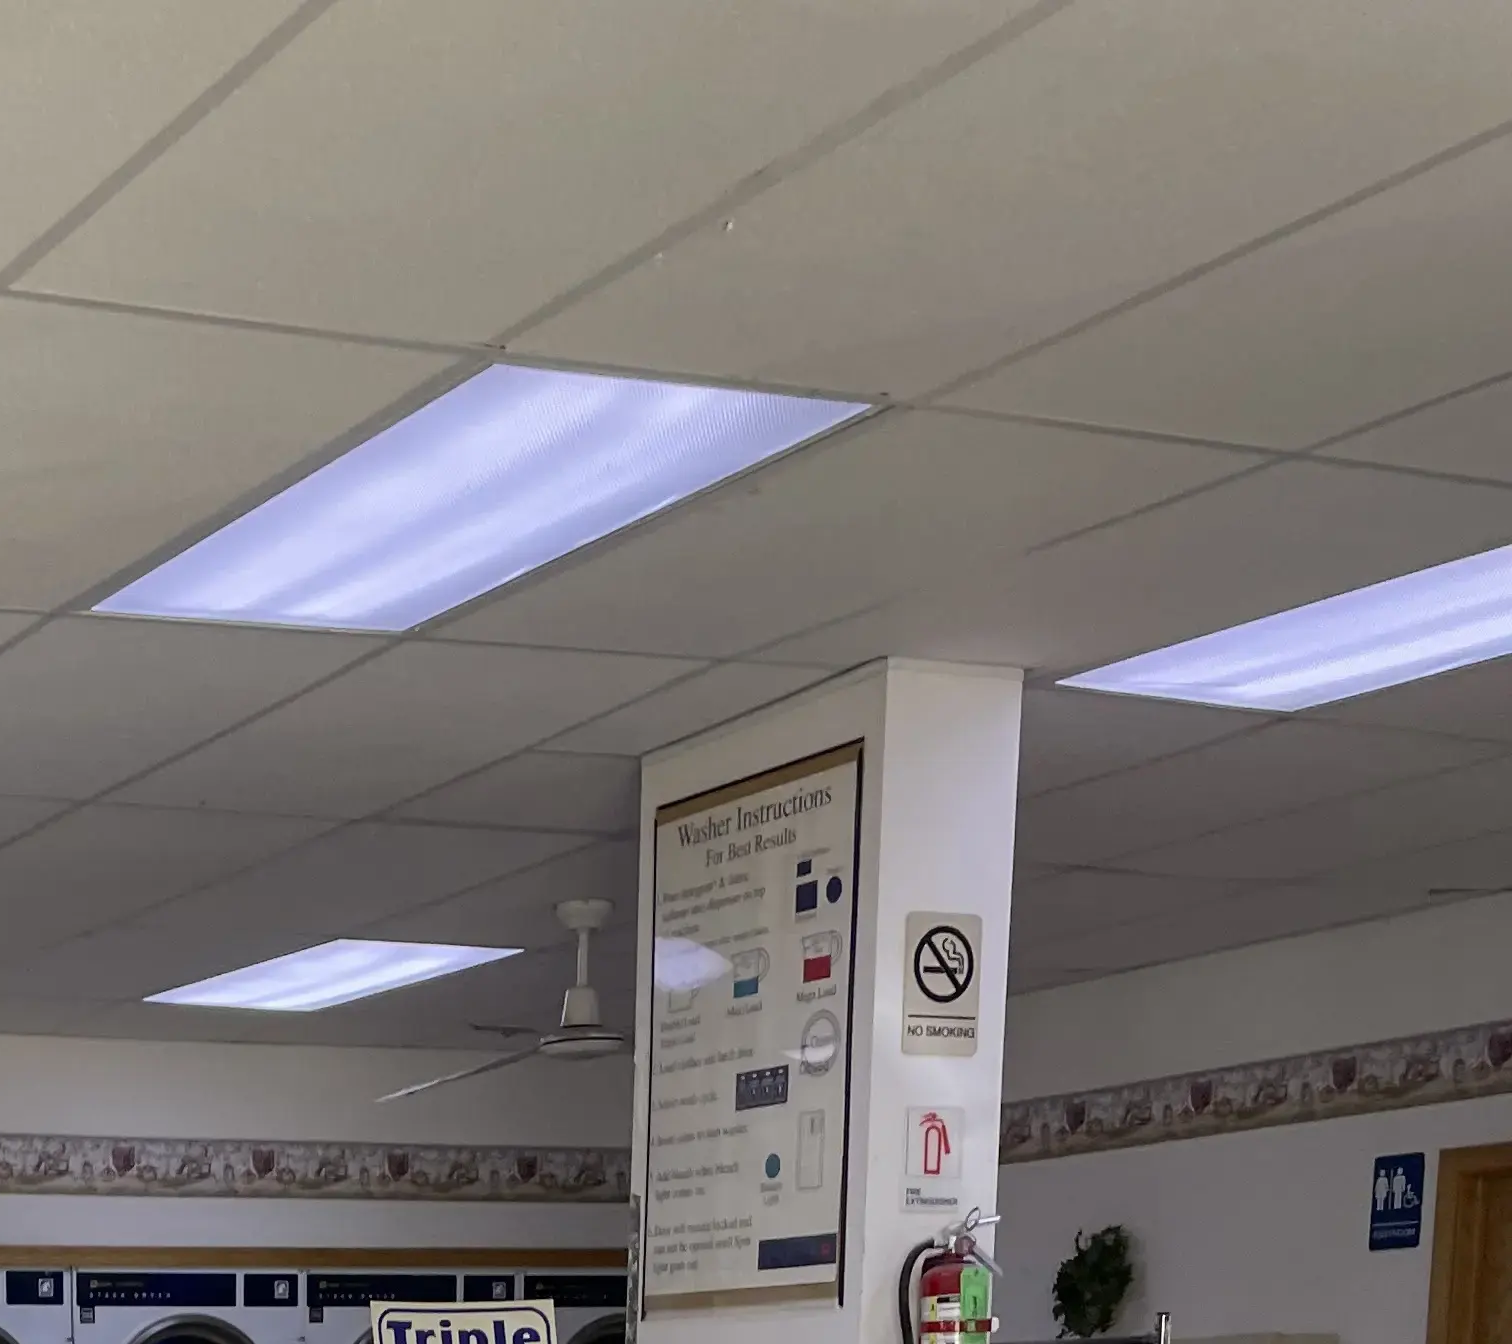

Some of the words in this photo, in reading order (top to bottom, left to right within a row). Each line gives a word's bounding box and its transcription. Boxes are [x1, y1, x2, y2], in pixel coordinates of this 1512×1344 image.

[678, 814, 732, 848] Washer
[737, 785, 833, 832] Instructions
[705, 848, 724, 868] For
[727, 840, 752, 862] Best
[754, 827, 797, 853] Results
[907, 1025, 923, 1037] NO
[925, 1025, 975, 1038] SMOKING
